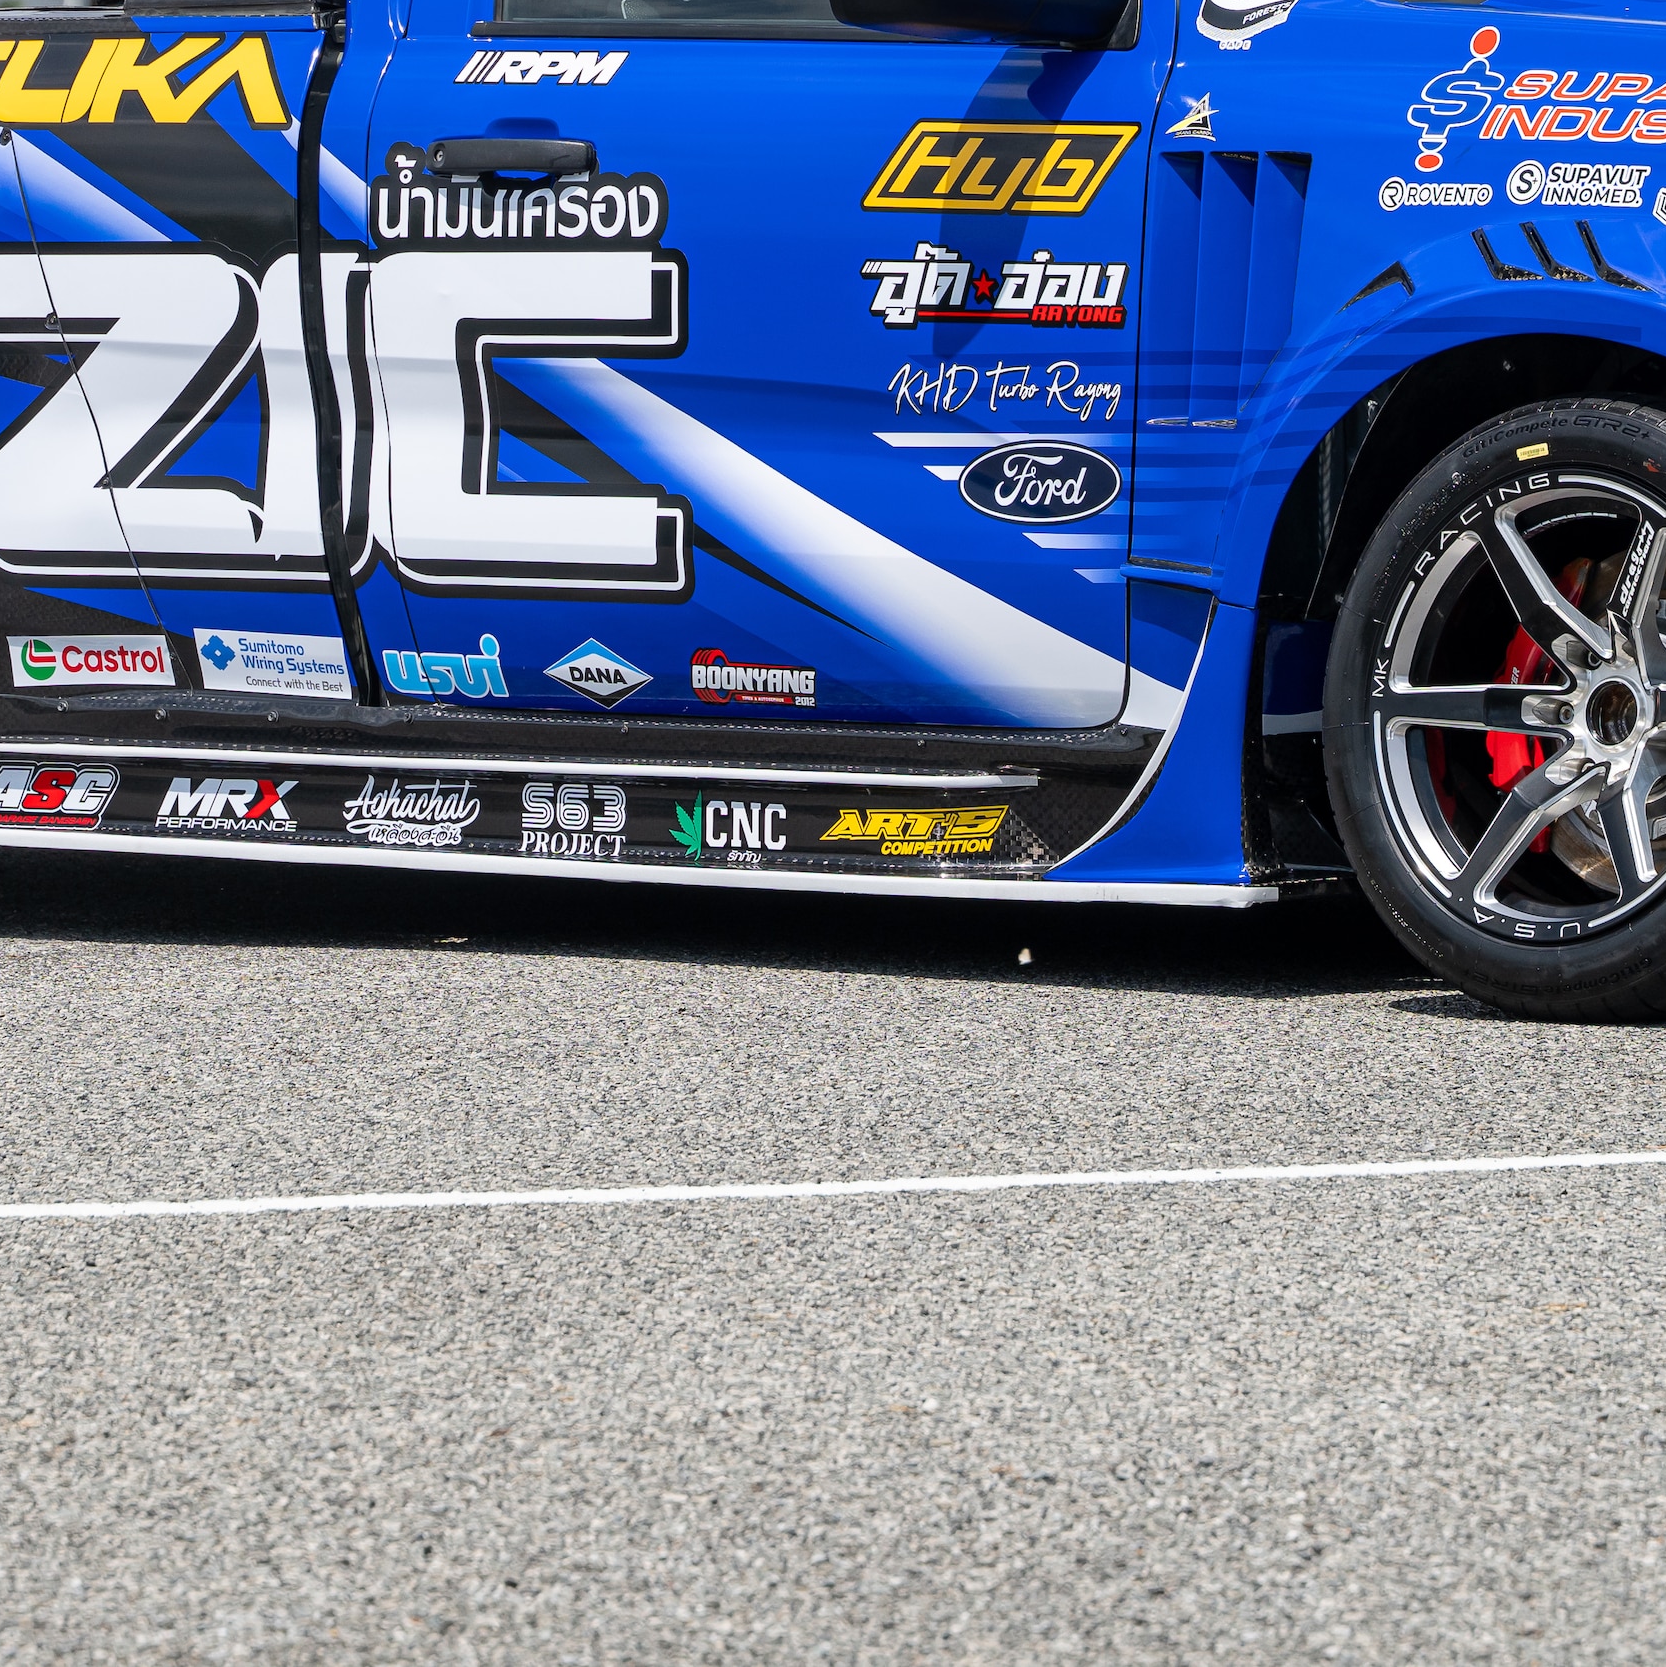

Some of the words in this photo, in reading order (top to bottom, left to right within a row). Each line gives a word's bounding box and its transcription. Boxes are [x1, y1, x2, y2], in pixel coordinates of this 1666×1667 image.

[1242, 2, 1292, 25] FORESTS
[483, 50, 631, 85] RPM
[886, 135, 1096, 209] Hyb
[1549, 165, 1650, 187] SUPAVUT
[1407, 185, 1490, 206] ROVENTO
[1541, 186, 1643, 206] INNOMED.
[1031, 305, 1125, 323] RAYONG
[887, 362, 979, 415] KHD
[986, 361, 1039, 412] Turbo
[1046, 360, 1122, 422] Rayong
[995, 453, 1087, 508] Ford
[1371, 657, 1390, 698] MK
[1415, 472, 1551, 577] RACING
[61, 643, 166, 673] Castrol
[238, 637, 305, 656] Sumitomo
[241, 654, 284, 674] Wiring
[286, 657, 345, 675] Systems
[567, 665, 629, 685] DANA
[245, 675, 282, 688] Connect
[284, 678, 304, 689] with
[305, 680, 321, 691] the
[322, 680, 344, 692] Best
[691, 664, 816, 694] BOONYANG
[795, 696, 816, 707] 2012
[157, 777, 299, 820] MRX
[520, 782, 627, 832] S63
[154, 816, 298, 832] PERFORMANCE
[705, 800, 788, 851] CNC
[519, 830, 627, 857] PROJECT
[880, 838, 994, 856] COMPETITION
